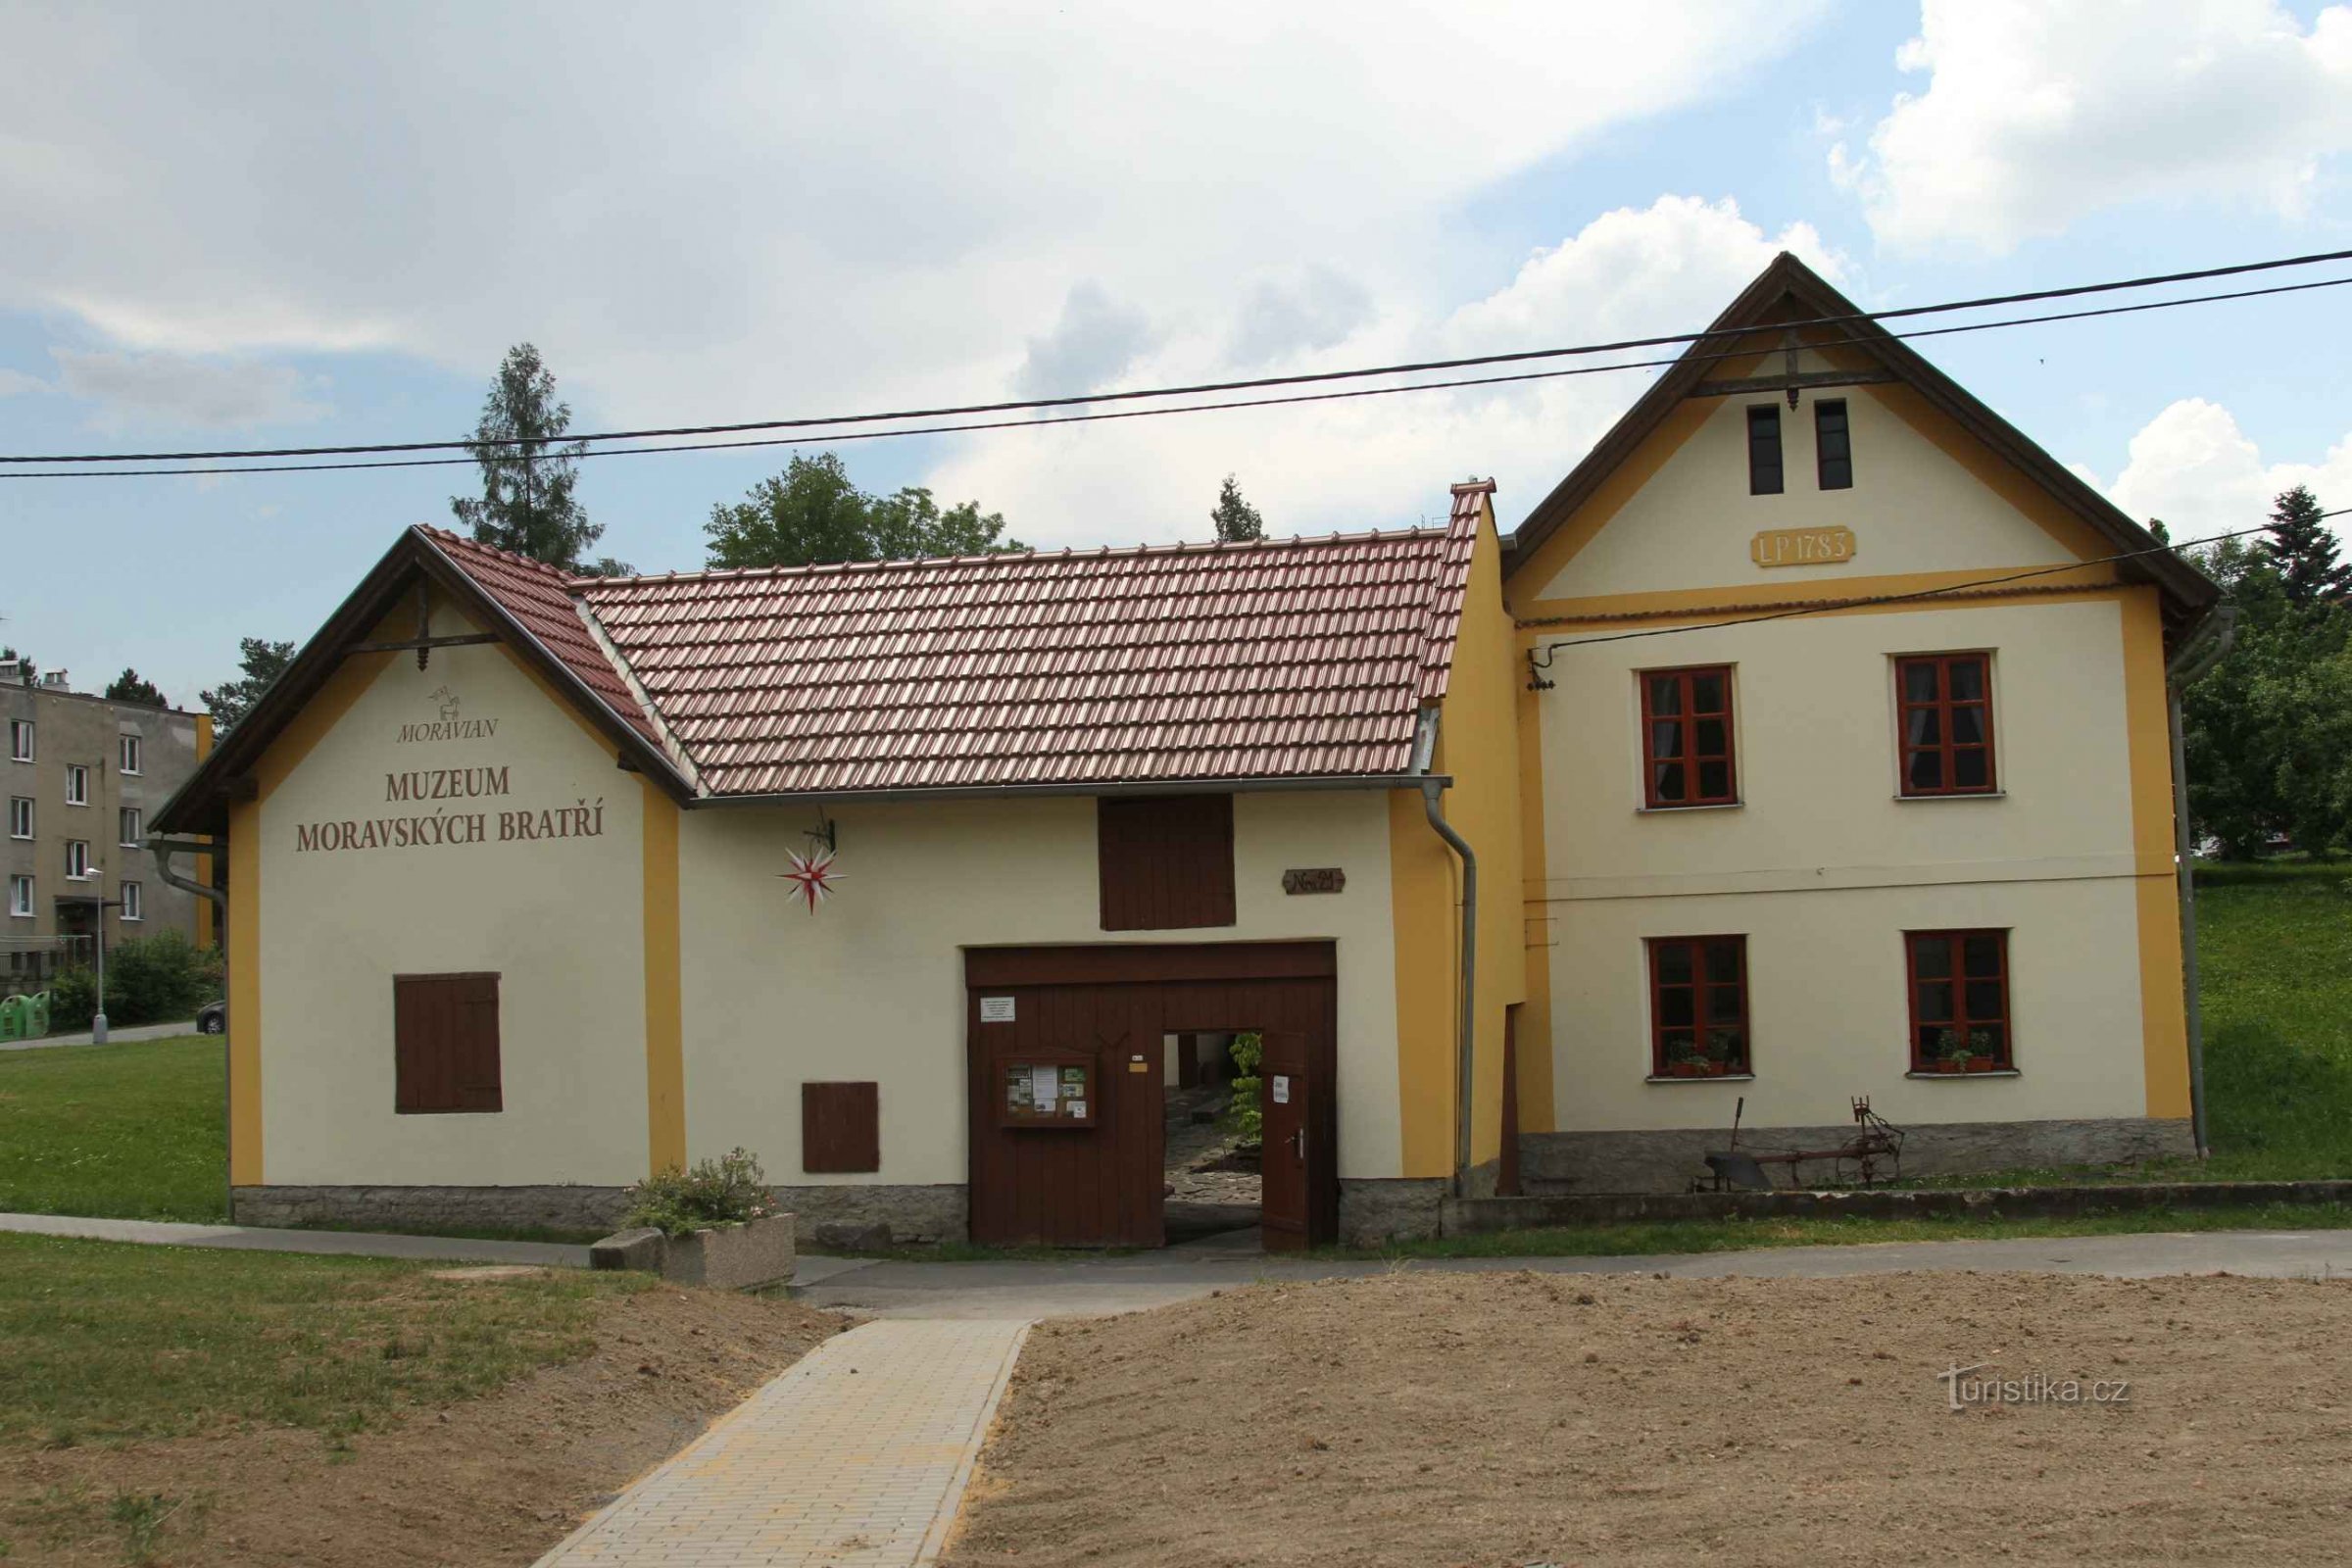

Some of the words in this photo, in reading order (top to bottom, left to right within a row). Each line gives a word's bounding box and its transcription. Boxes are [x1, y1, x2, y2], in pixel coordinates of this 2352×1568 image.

[396, 717, 499, 744] MORAVIAN
[385, 765, 511, 802] MUZEUM
[295, 807, 486, 853] MORAVSKÝCH
[497, 796, 605, 842] BRATŘÍ
